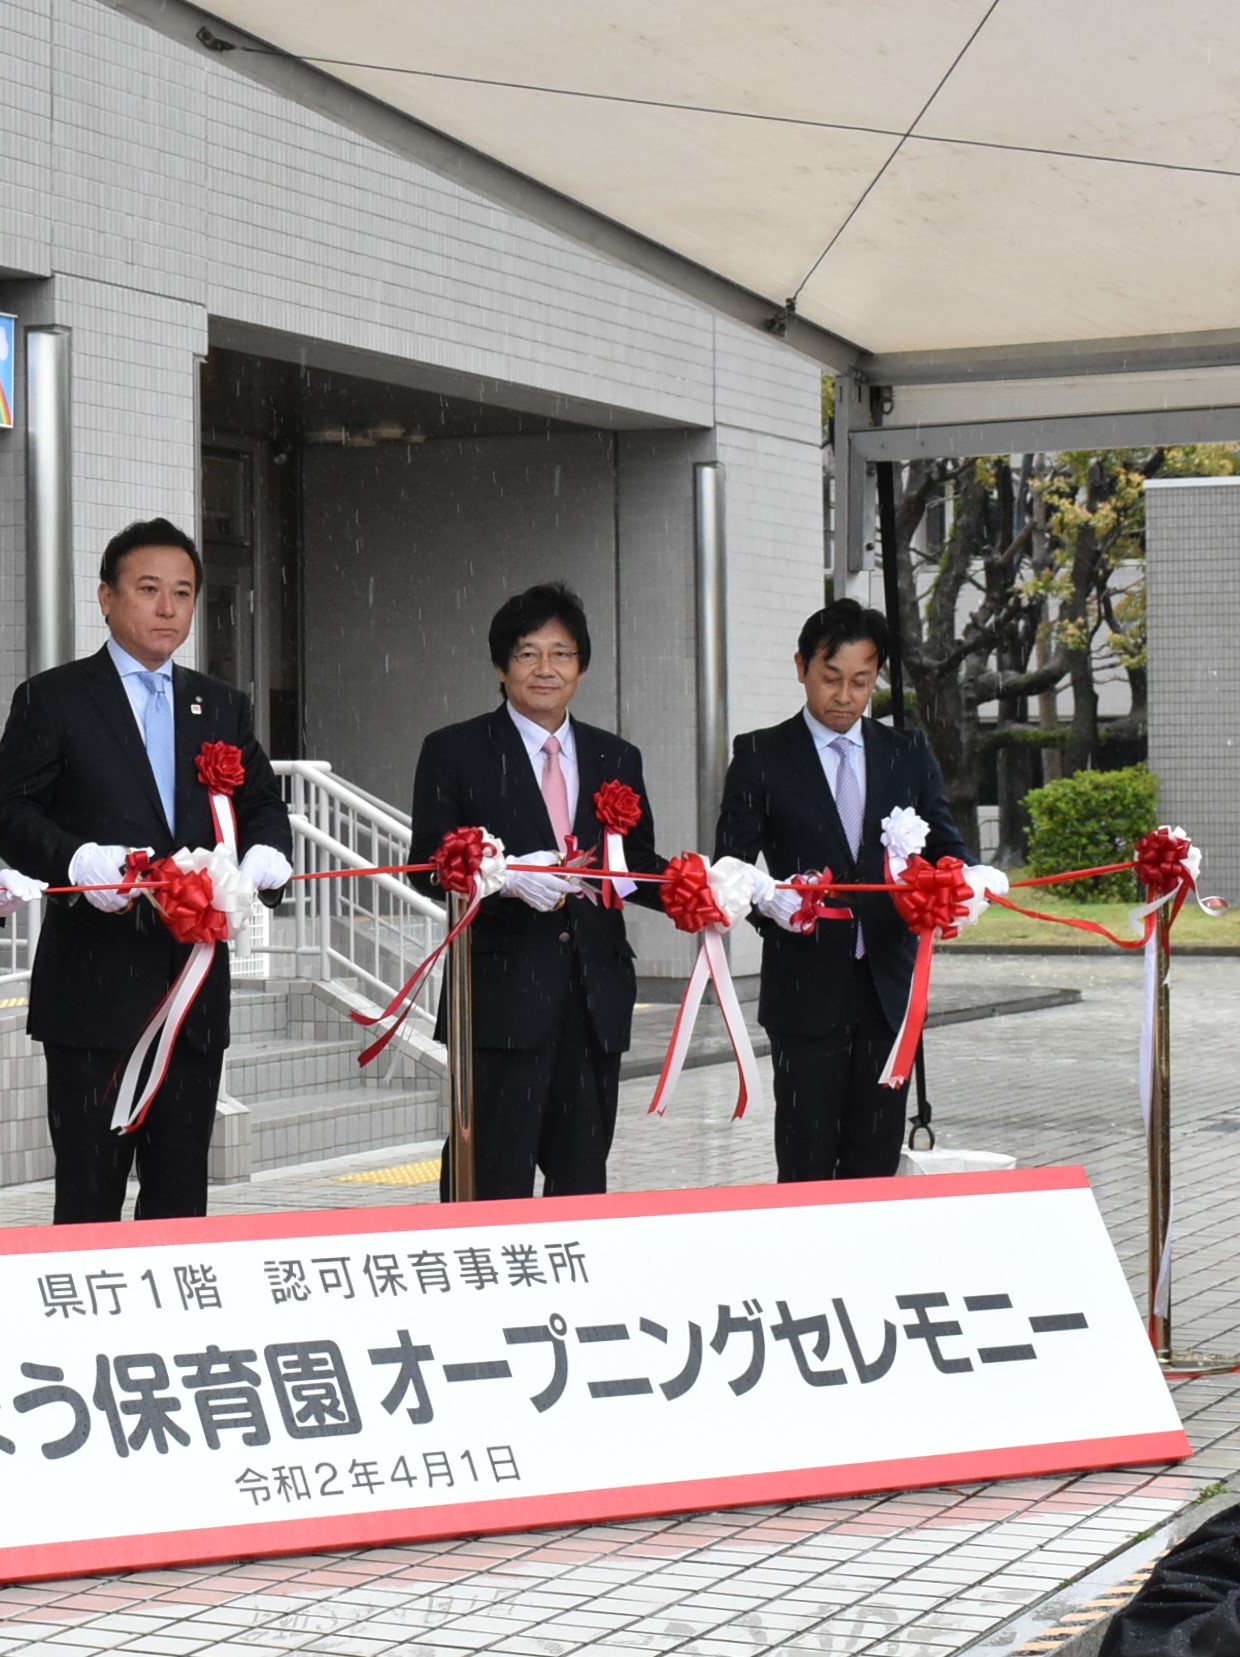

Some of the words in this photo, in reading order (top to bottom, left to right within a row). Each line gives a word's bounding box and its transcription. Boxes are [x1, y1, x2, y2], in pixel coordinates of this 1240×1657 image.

[264, 1242, 589, 1303] 認可保育事業所
[235, 1445, 521, 1506] 令和2年4月1日
